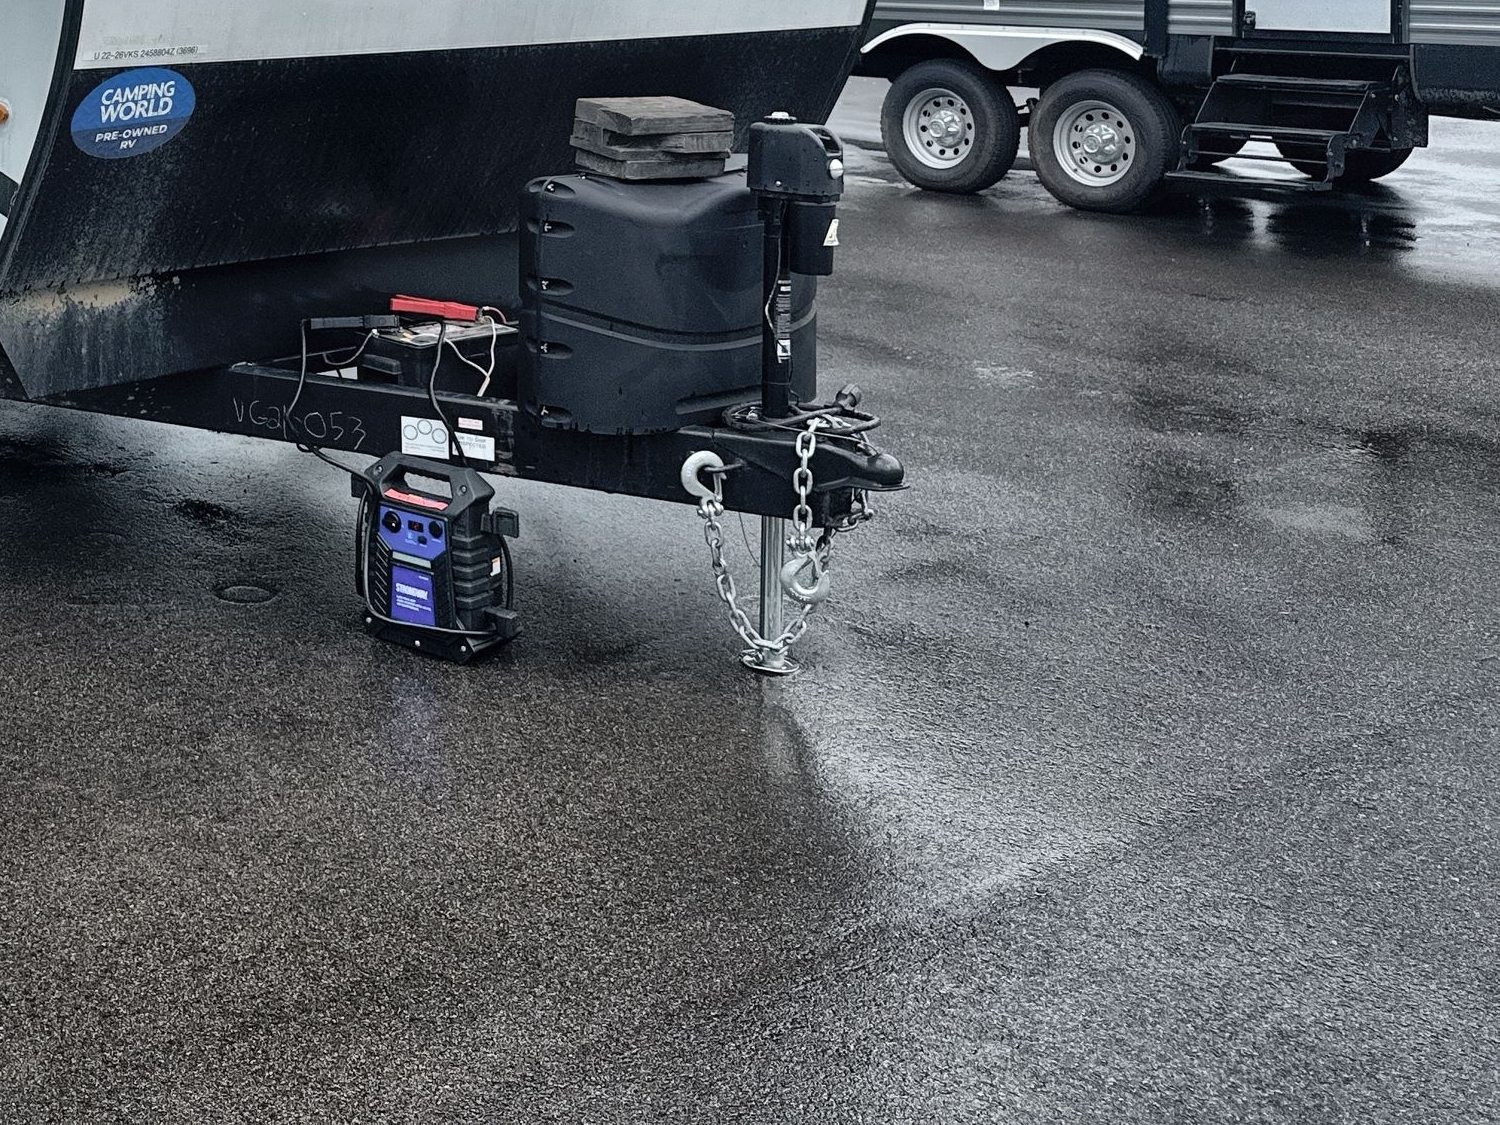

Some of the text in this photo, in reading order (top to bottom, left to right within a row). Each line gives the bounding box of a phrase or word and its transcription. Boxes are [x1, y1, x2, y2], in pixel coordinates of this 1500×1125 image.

[101, 80, 175, 105] CAMPING
[100, 97, 173, 123] WORLD
[95, 124, 168, 143] PRE-OWNED
[119, 139, 137, 150] RV
